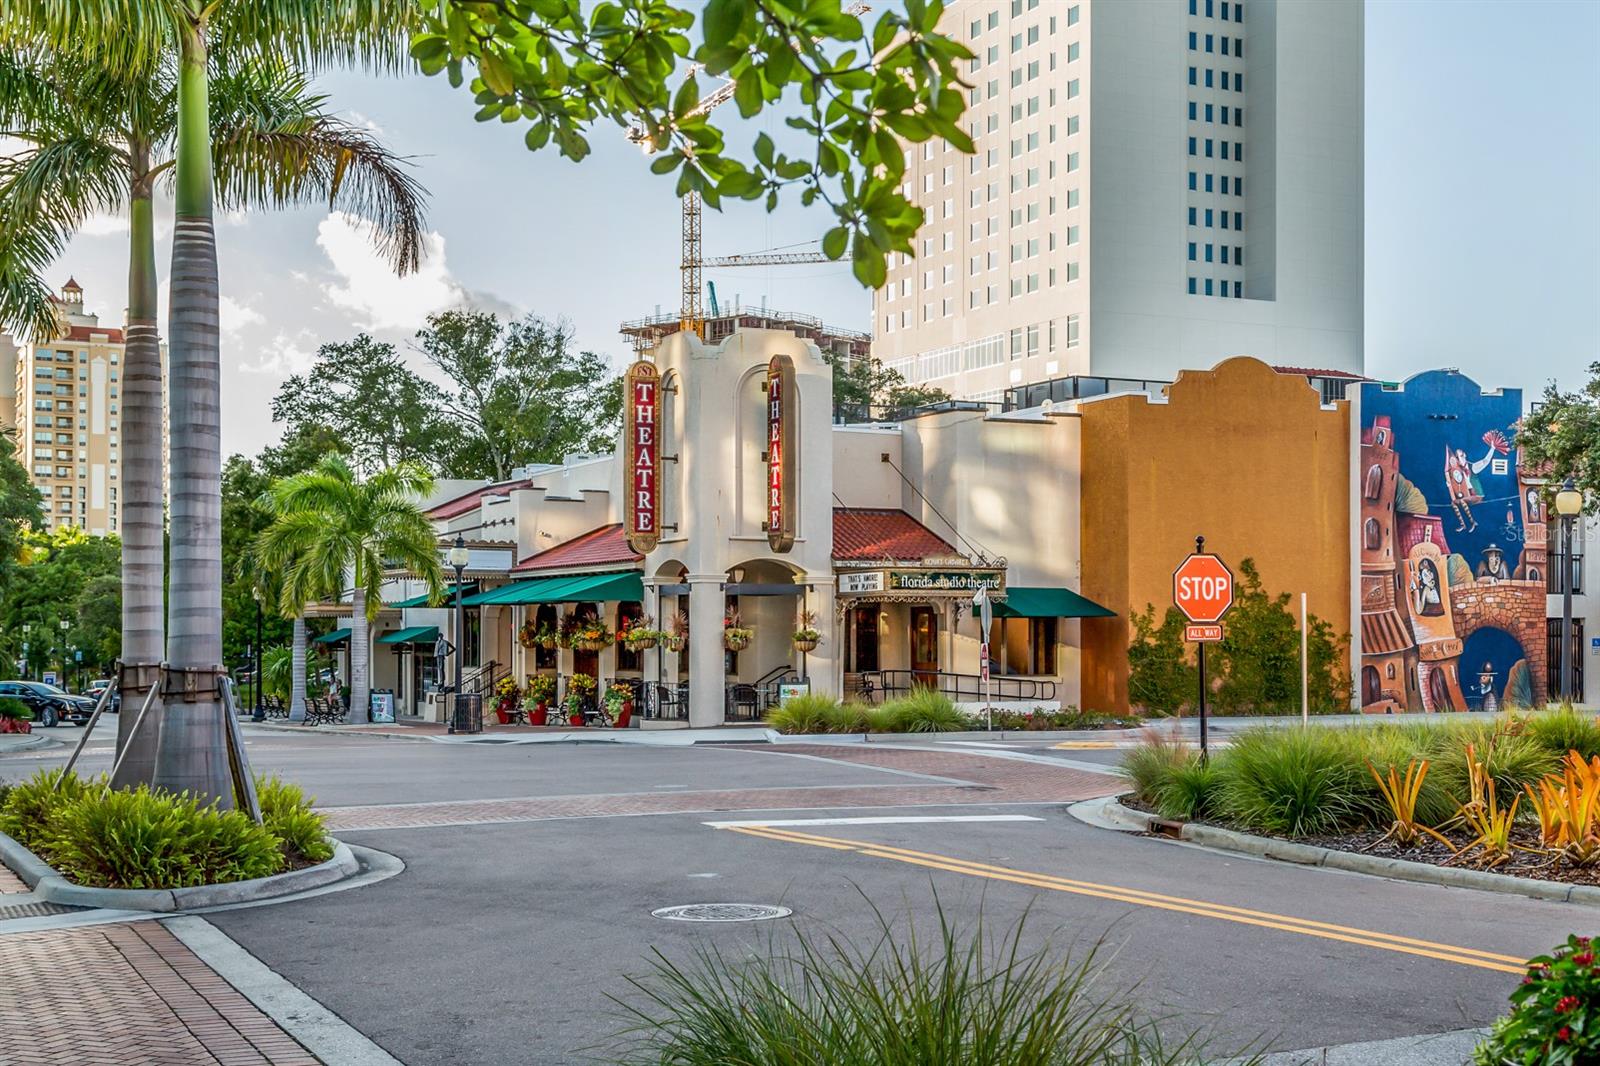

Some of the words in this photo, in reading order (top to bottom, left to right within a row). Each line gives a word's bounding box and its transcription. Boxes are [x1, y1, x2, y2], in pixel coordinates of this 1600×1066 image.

[636, 383, 652, 532] THEATRE
[771, 378, 780, 529] THEATRE
[850, 583, 859, 591] NOW
[861, 582, 878, 591] PLAYING
[901, 575, 933, 588] florida
[936, 576, 965, 590] studio
[967, 574, 1000, 589] theatre
[1179, 576, 1228, 601] STOP
[1190, 629, 1202, 637] ALL
[1205, 629, 1218, 637] WAY
